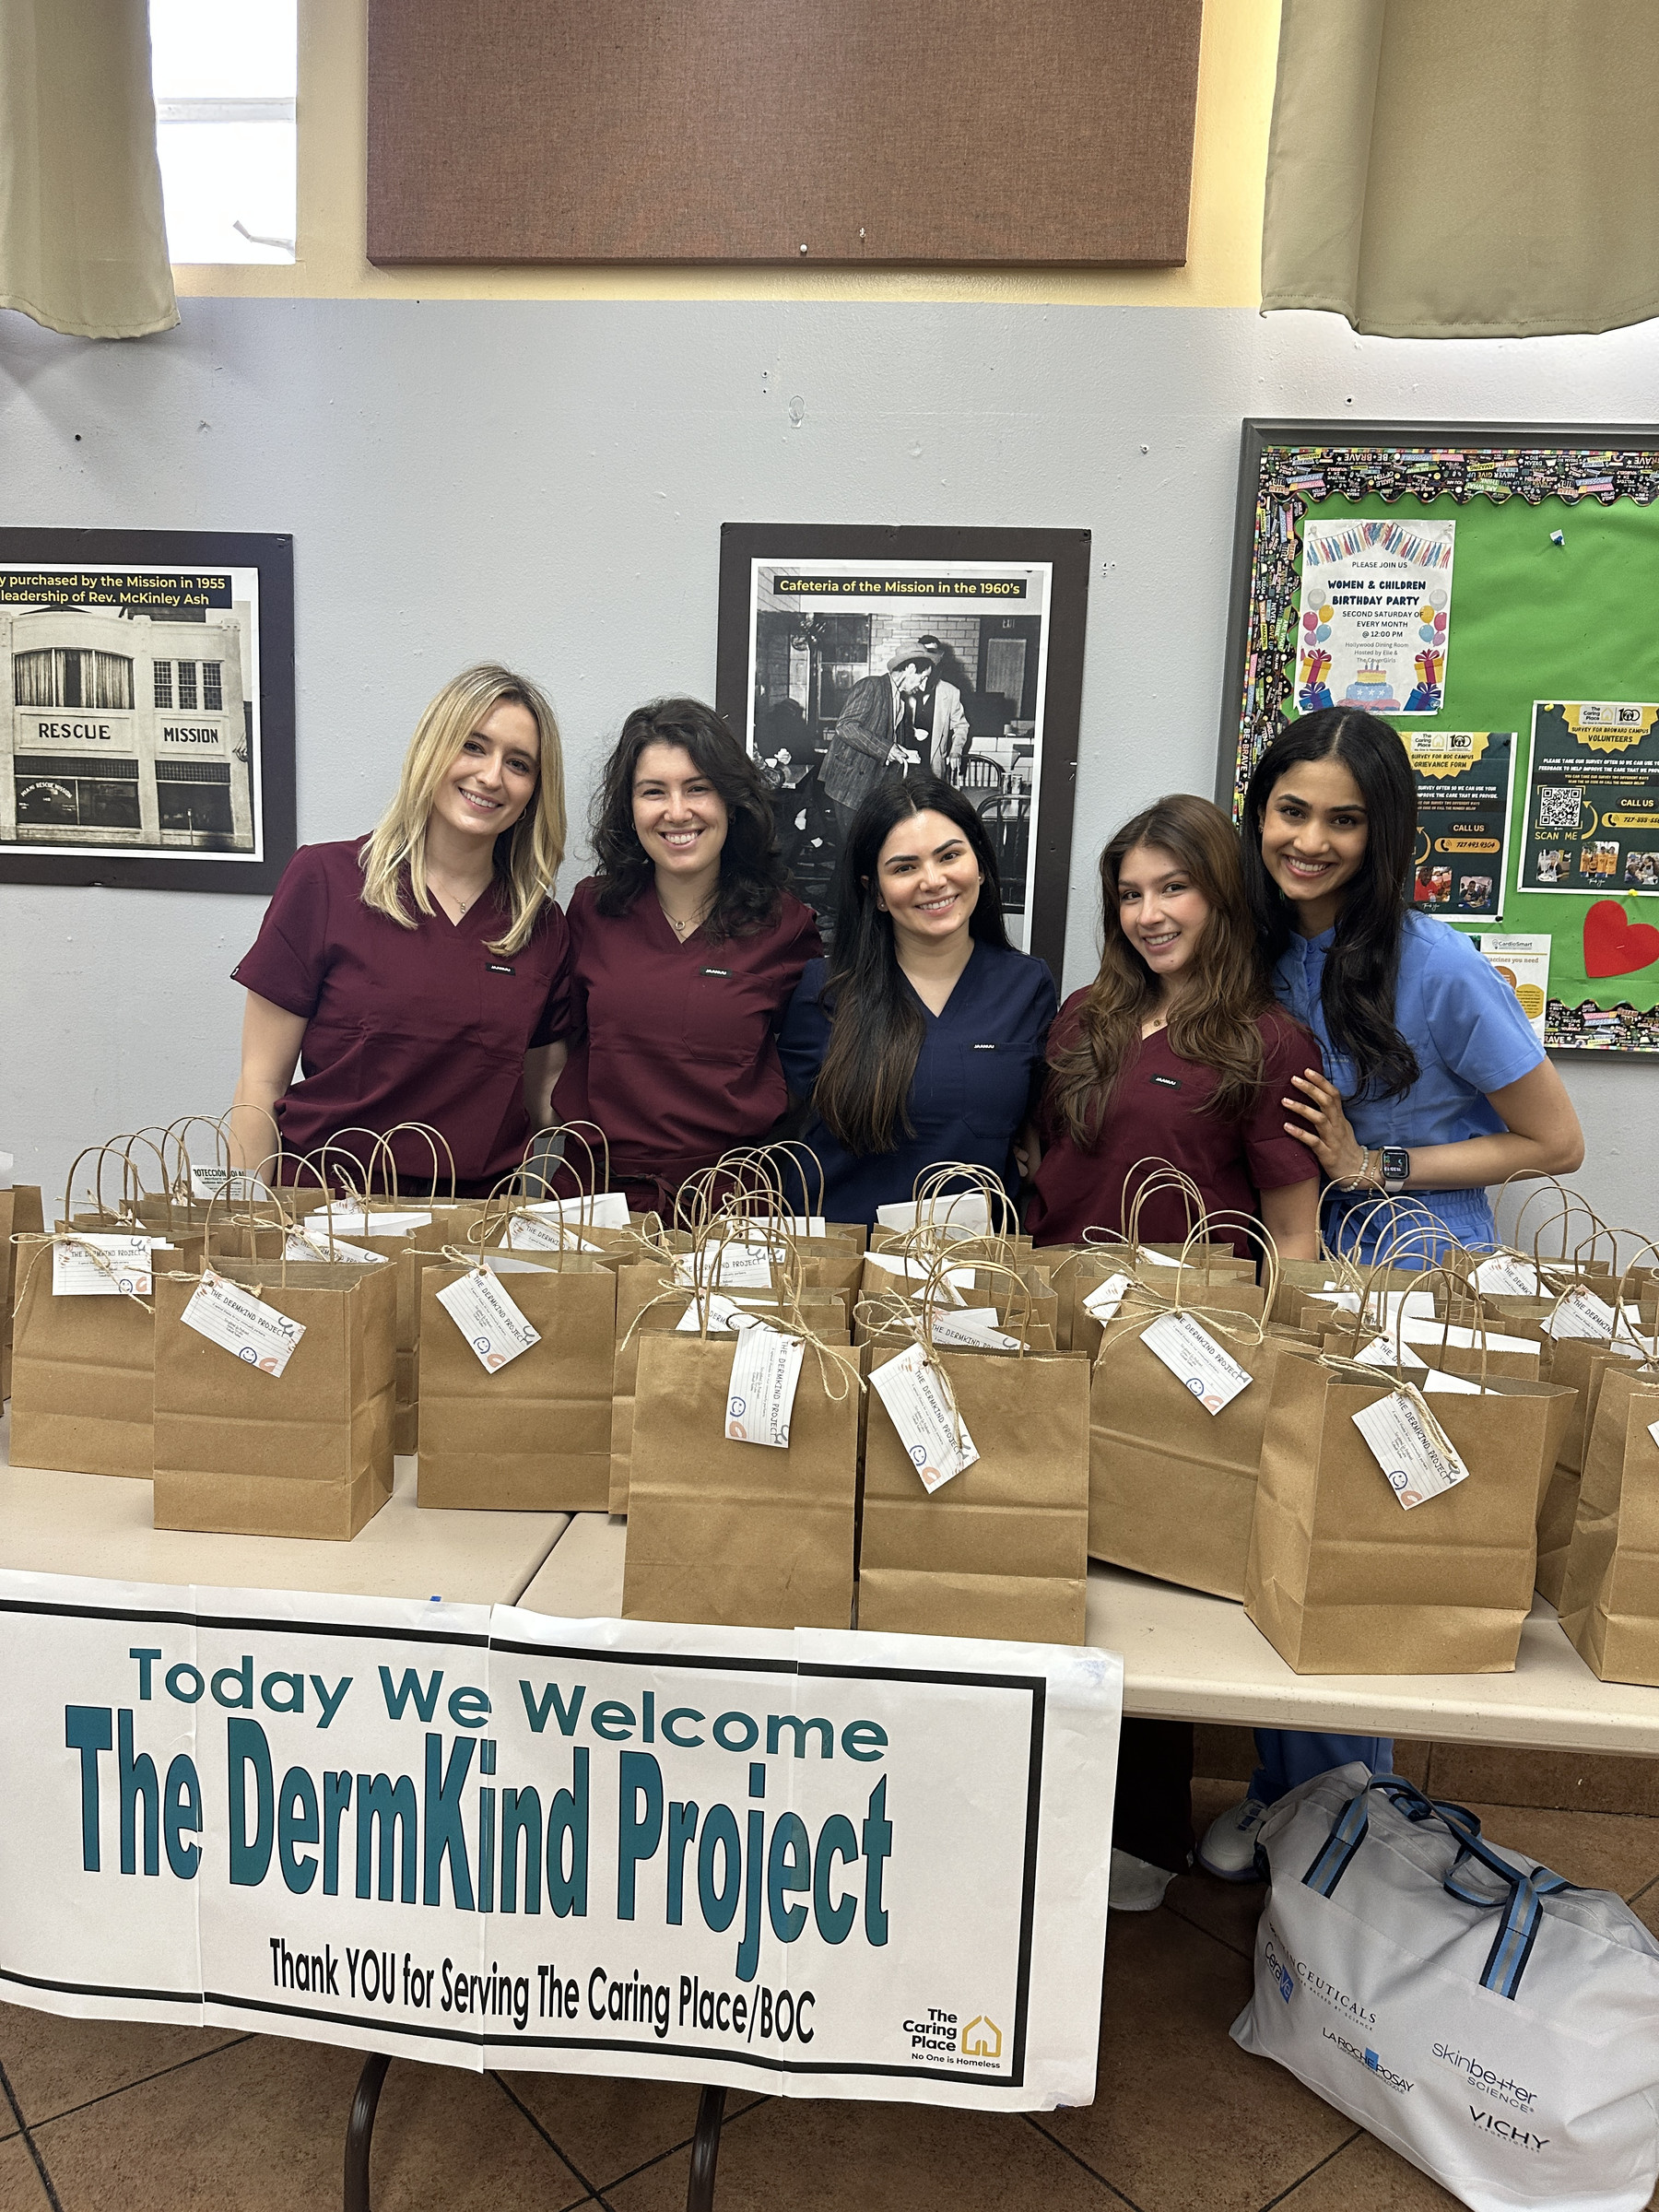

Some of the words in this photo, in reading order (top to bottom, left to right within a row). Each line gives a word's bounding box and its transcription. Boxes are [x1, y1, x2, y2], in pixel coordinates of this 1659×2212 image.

[9, 574, 77, 587] purchased
[81, 575, 96, 588] by
[100, 576, 124, 588] the
[127, 576, 177, 588] Mission
[181, 577, 194, 588] in
[197, 578, 225, 589] 1955
[780, 580, 839, 593] Cafeteria
[842, 581, 857, 593] of
[859, 581, 881, 593] the
[885, 581, 935, 594] Mission
[938, 582, 951, 594] in
[955, 582, 977, 594] the
[981, 582, 1020, 594] 1960's
[1327, 581, 1364, 590] WOMEN
[1368, 581, 1375, 590] &
[1379, 581, 1427, 590] CHILDREN
[2, 590, 68, 603] leadership
[72, 591, 86, 603] of
[88, 592, 116, 603] Rev.
[120, 593, 181, 606] McKinley
[184, 594, 209, 605] Ash
[1332, 595, 1382, 605] BIRTHDAY
[1386, 595, 1419, 605] PARTY
[39, 724, 111, 741] RESCUE
[164, 727, 219, 743] MISSION
[1588, 735, 1633, 743] VOLUNTEERS
[1535, 831, 1559, 840] SCAN
[1565, 831, 1578, 840] ME
[526, 1226, 536, 1235] THE
[537, 1231, 566, 1249] DERMKID
[733, 1259, 760, 1268] PROJECT
[1504, 1266, 1513, 1277] THE
[210, 1288, 221, 1300] THE
[223, 1297, 256, 1321] DERMKIND
[258, 1318, 286, 1338] PROJECT
[474, 1276, 485, 1288] THE
[482, 1288, 506, 1318] DERMKIND
[504, 1318, 524, 1343] PROJECT
[1572, 1299, 1584, 1311] THE
[933, 1324, 942, 1333] THE
[780, 1341, 789, 1355] THE
[1185, 1324, 1215, 1355] DERMKIND
[1215, 1353, 1241, 1380] PROJECT
[1379, 1344, 1394, 1357] THE
[773, 1359, 786, 1400] DERMKIND
[771, 1403, 780, 1436] PROJECT
[914, 1370, 925, 1382] THE
[923, 1386, 945, 1423] DERMKIND
[942, 1425, 962, 1454] PROJECT
[1395, 1396, 1408, 1411] THE
[1406, 1411, 1430, 1450] DERMKIND
[1428, 1449, 1449, 1480] PROJECT
[129, 1647, 353, 1729] Today
[380, 1665, 492, 1729] We
[520, 1679, 889, 1763] Welcome
[65, 1704, 204, 1879] The
[227, 1716, 591, 1918] DermKind
[618, 1748, 894, 1983] Project
[1265, 1941, 1293, 1999] CeraVe
[270, 1936, 340, 1998] Thank
[347, 1947, 395, 1999] YOU
[402, 1954, 436, 2007] for
[441, 1959, 529, 2030] Serving
[537, 1965, 582, 2017] The
[587, 1968, 670, 2041] Caring
[679, 1975, 817, 2045] Place/BOC
[927, 2007, 958, 2023] The
[903, 2019, 957, 2040] Caring
[912, 2035, 957, 2052] Place
[926, 2053, 945, 2063] One
[957, 2057, 1001, 2068] Homeless
[1337, 2037, 1374, 2068] ROCHE
[1376, 2065, 1414, 2092] POSAY
[1432, 2042, 1537, 2104] skinbetter
[1469, 2105, 1550, 2149] VICHY
